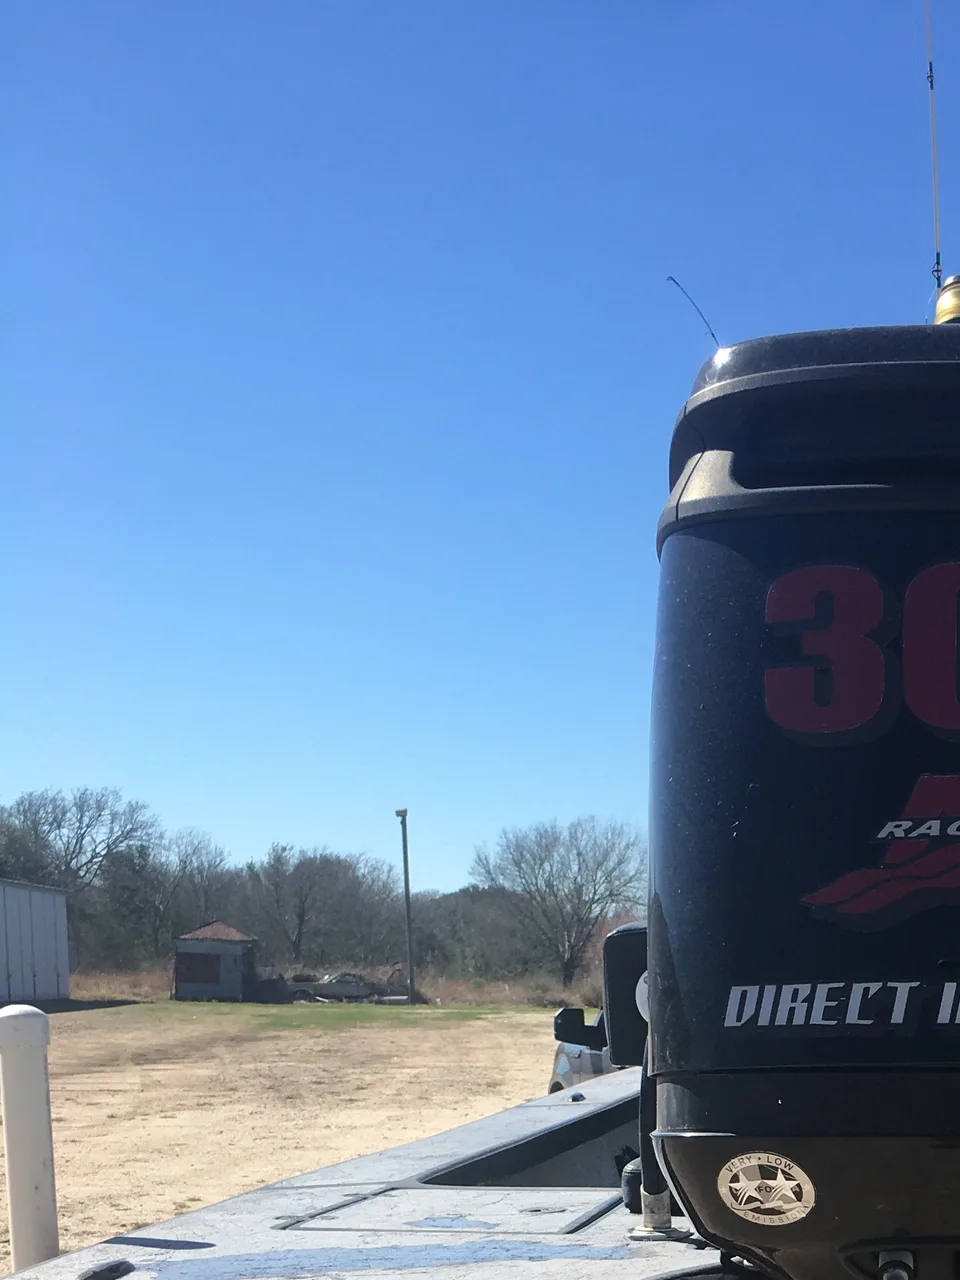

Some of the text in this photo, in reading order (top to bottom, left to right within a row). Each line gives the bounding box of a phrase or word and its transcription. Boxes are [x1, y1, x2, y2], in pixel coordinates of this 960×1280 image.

[724, 981, 921, 1028] DIRECT
[725, 1155, 794, 1173] VERY LOW
